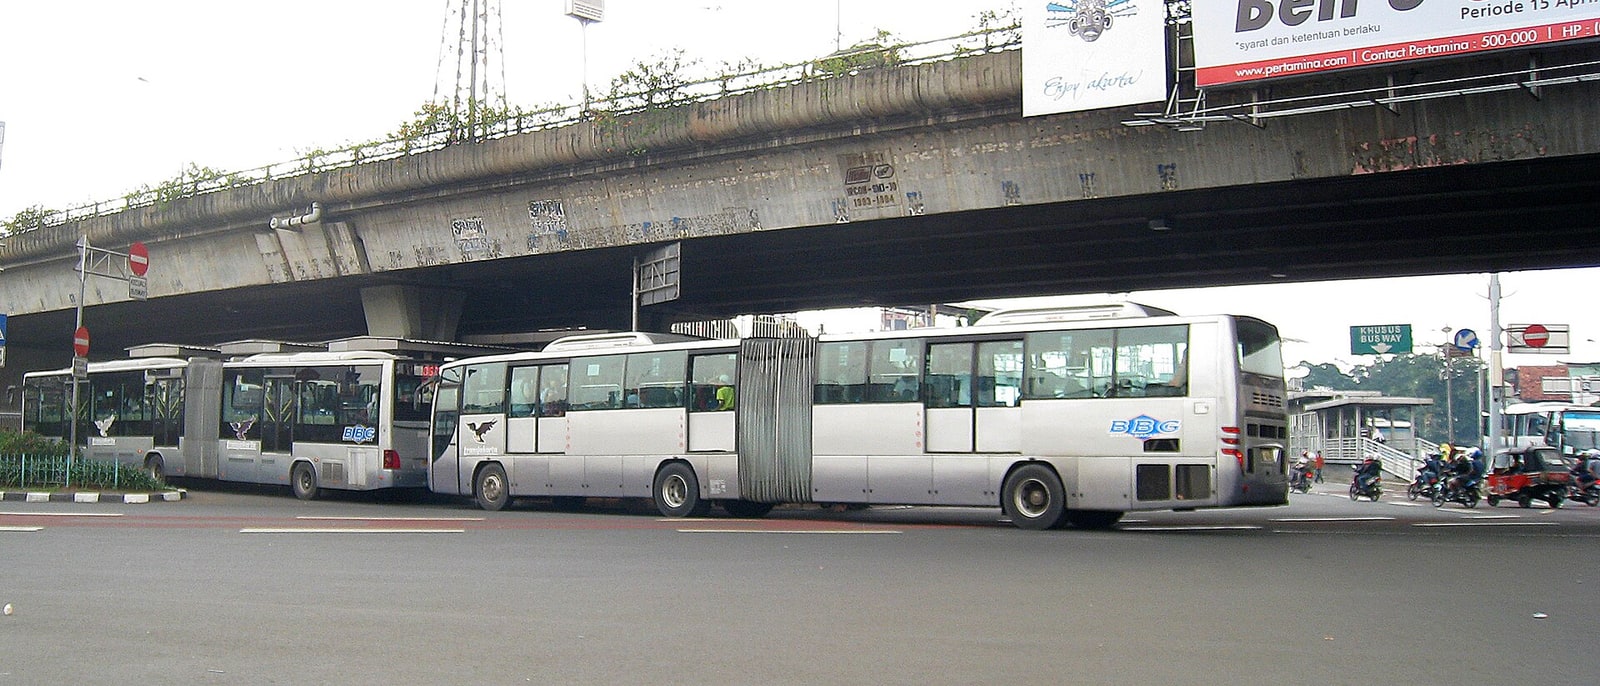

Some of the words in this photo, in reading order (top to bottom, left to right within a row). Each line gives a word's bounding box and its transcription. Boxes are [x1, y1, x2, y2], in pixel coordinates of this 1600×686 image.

[1460, 3, 1524, 20] Periode
[1531, 0, 1549, 11] 15
[1271, 36, 1290, 46] dan
[1292, 30, 1340, 43] ketentuan
[1343, 23, 1381, 37] berlaku
[1235, 56, 1347, 77] www.pertamina.com
[1361, 46, 1407, 62] Contact
[1409, 43, 1469, 57] Pertamina
[1480, 30, 1537, 48] 500-000
[1562, 24, 1582, 38] HP
[1043, 76, 1081, 101] Enjoy
[1360, 325, 1401, 335] KHUSUS
[1109, 419, 1181, 434] BBG
